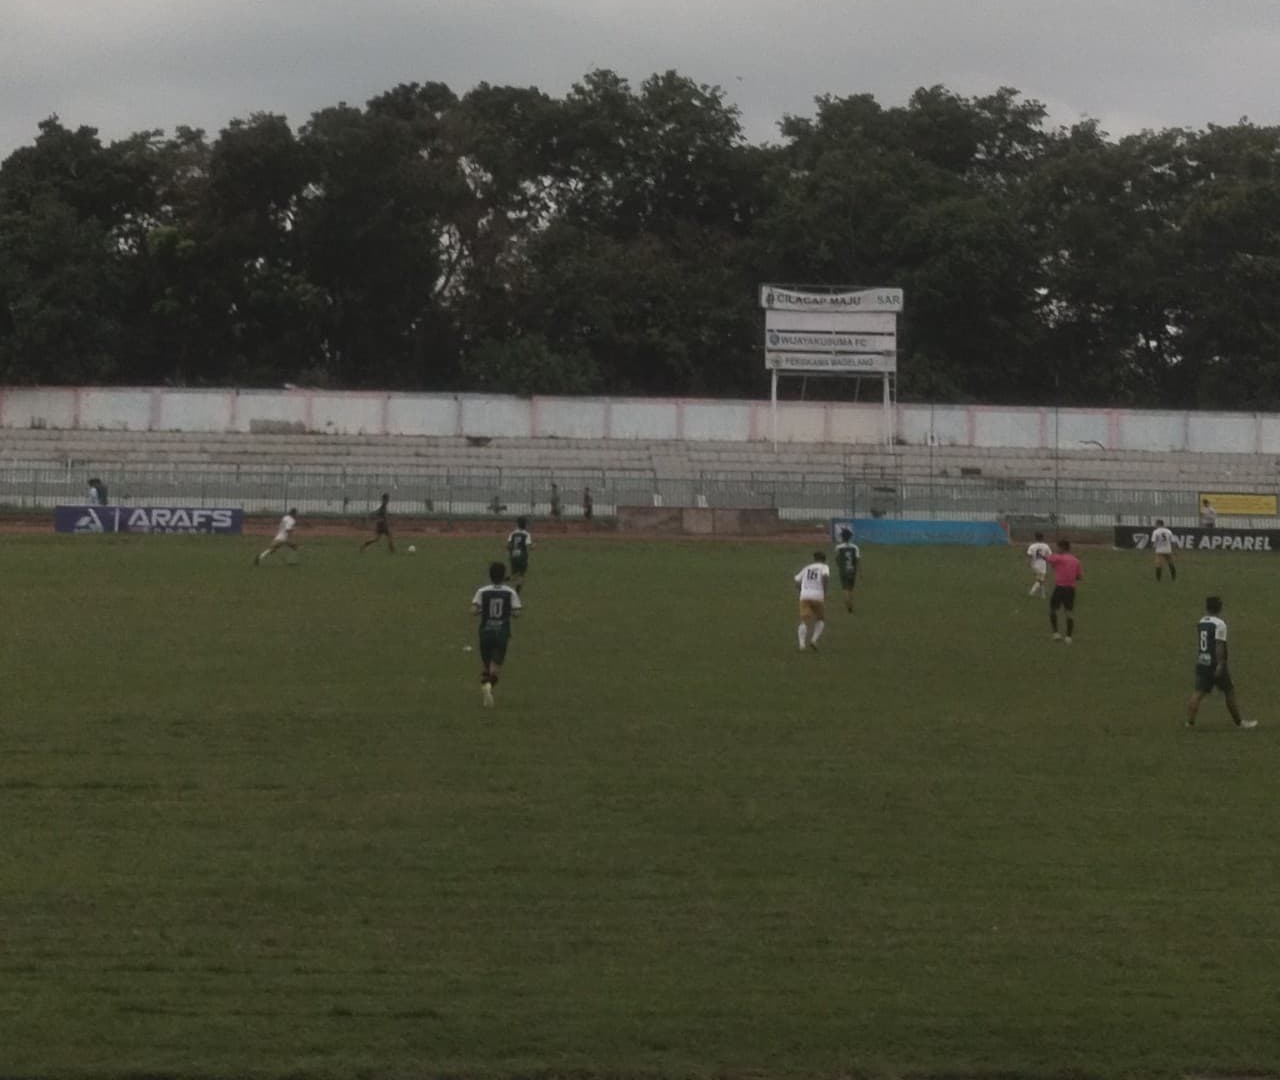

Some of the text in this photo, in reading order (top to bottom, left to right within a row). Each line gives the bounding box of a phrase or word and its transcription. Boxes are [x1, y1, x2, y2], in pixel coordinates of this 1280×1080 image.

[829, 296, 861, 306] MAJU
[855, 339, 867, 347] FC
[128, 508, 232, 528] ARAFS
[1199, 534, 1272, 550] APPAREL
[488, 597, 503, 618] 10
[1200, 630, 1208, 651] 8
